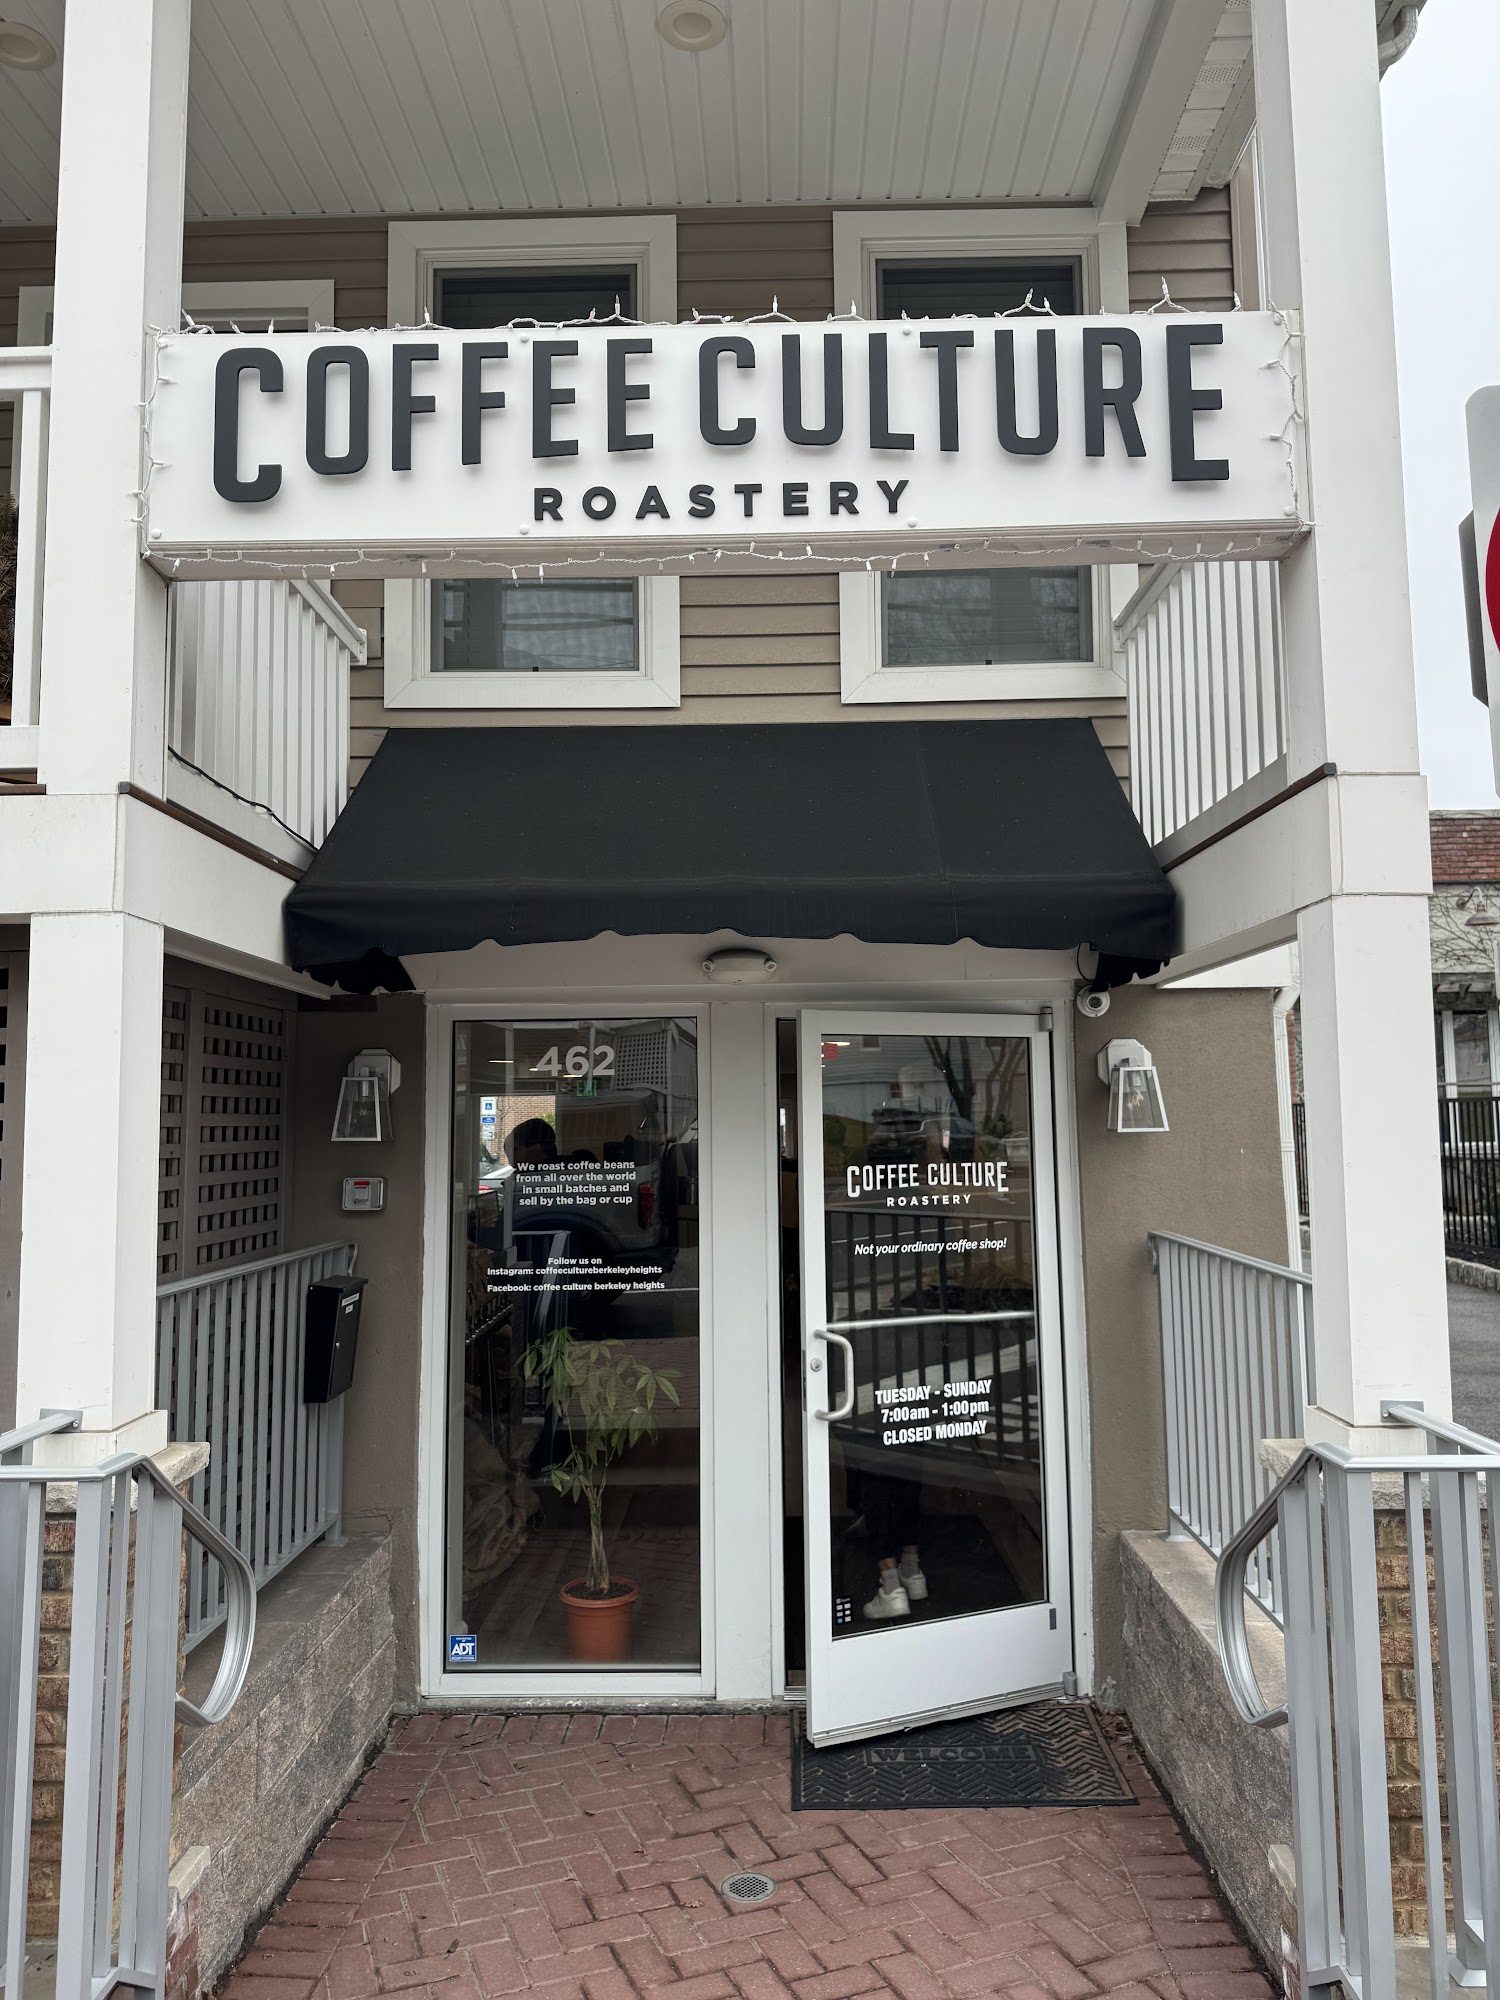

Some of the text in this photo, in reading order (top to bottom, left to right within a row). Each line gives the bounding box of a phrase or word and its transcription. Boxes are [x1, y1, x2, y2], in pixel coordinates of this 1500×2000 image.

[213, 323, 1230, 504] COFFEE CULTURE
[534, 479, 909, 521] ROASTERY
[535, 1045, 615, 1077] 462
[517, 1160, 635, 1171] We roast coffee beans
[516, 1171, 636, 1182] from all over the world
[847, 1161, 1009, 1198] COFFEE CULTURE
[522, 1183, 630, 1194] in small batches and
[519, 1196, 633, 1206] sell by the bag or cup
[886, 1194, 972, 1207] ROASTERY
[854, 1237, 1007, 1257] Not your ordinary coffee shop!
[548, 1257, 577, 1265] Follow
[487, 1266, 663, 1276] Instagram: coffeecultureberkeleyheights
[487, 1284, 531, 1292] Facebook:
[533, 1283, 560, 1291] coffee
[594, 1282, 632, 1291] berkeley
[633, 1281, 665, 1291] heights
[875, 1385, 931, 1405] TUESDAY
[943, 1379, 992, 1397] SUNDAY
[880, 1406, 930, 1423] 7:00am
[941, 1399, 990, 1418] 1:00pm
[883, 1420, 988, 1446] CLOSED MONDAY
[452, 1643, 475, 1655] ADT
[874, 1747, 1031, 1761] WELCOME
